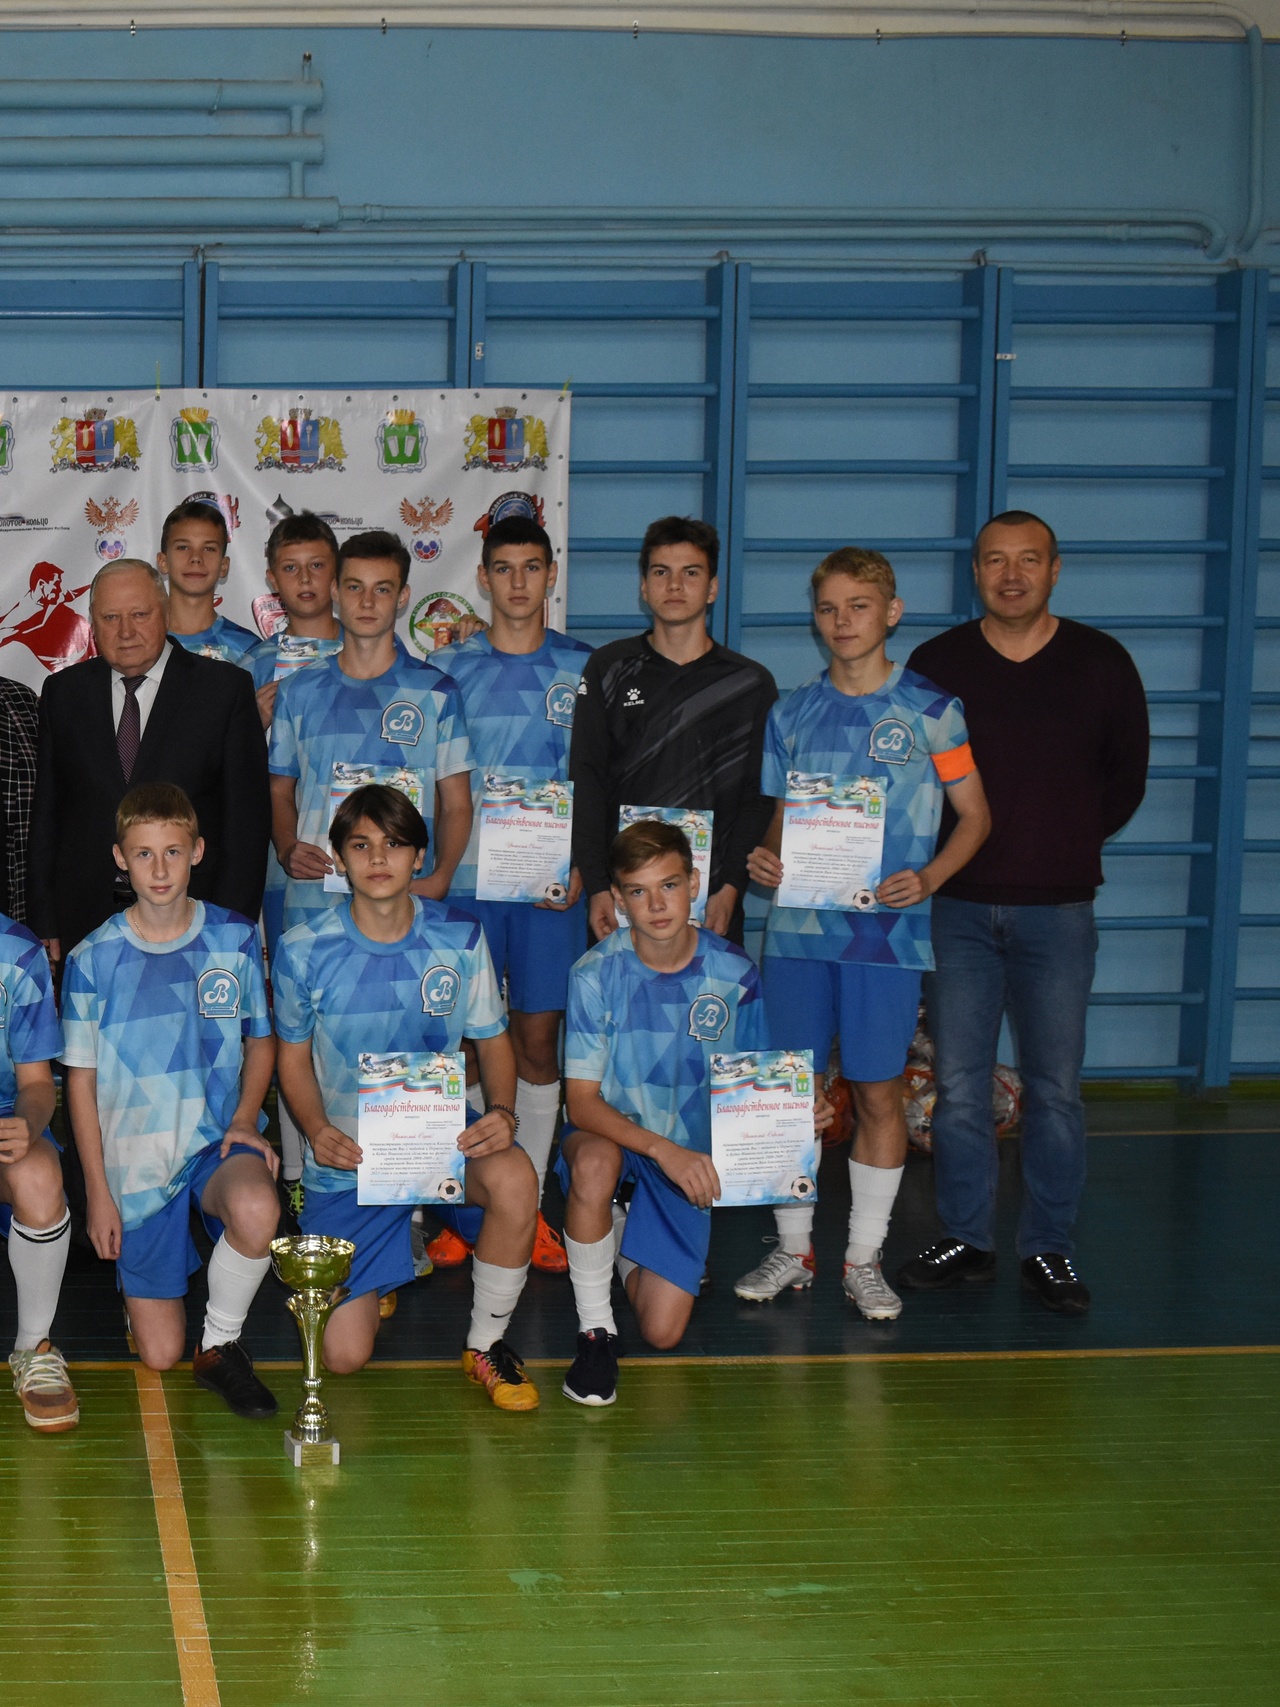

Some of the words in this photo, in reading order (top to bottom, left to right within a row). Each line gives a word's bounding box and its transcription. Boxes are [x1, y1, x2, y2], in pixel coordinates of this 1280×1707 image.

[26, 518, 48, 527] КОЛЬЦО
[486, 815, 542, 830] Благодарственное
[544, 820, 568, 829] письмо
[789, 815, 851, 830] Благодарственное
[854, 821, 880, 830] письмо
[364, 1100, 432, 1118] Благодарственное
[433, 1102, 460, 1112] письмо
[716, 1100, 780, 1118] Благодарственное
[782, 1101, 810, 1110] письмо
